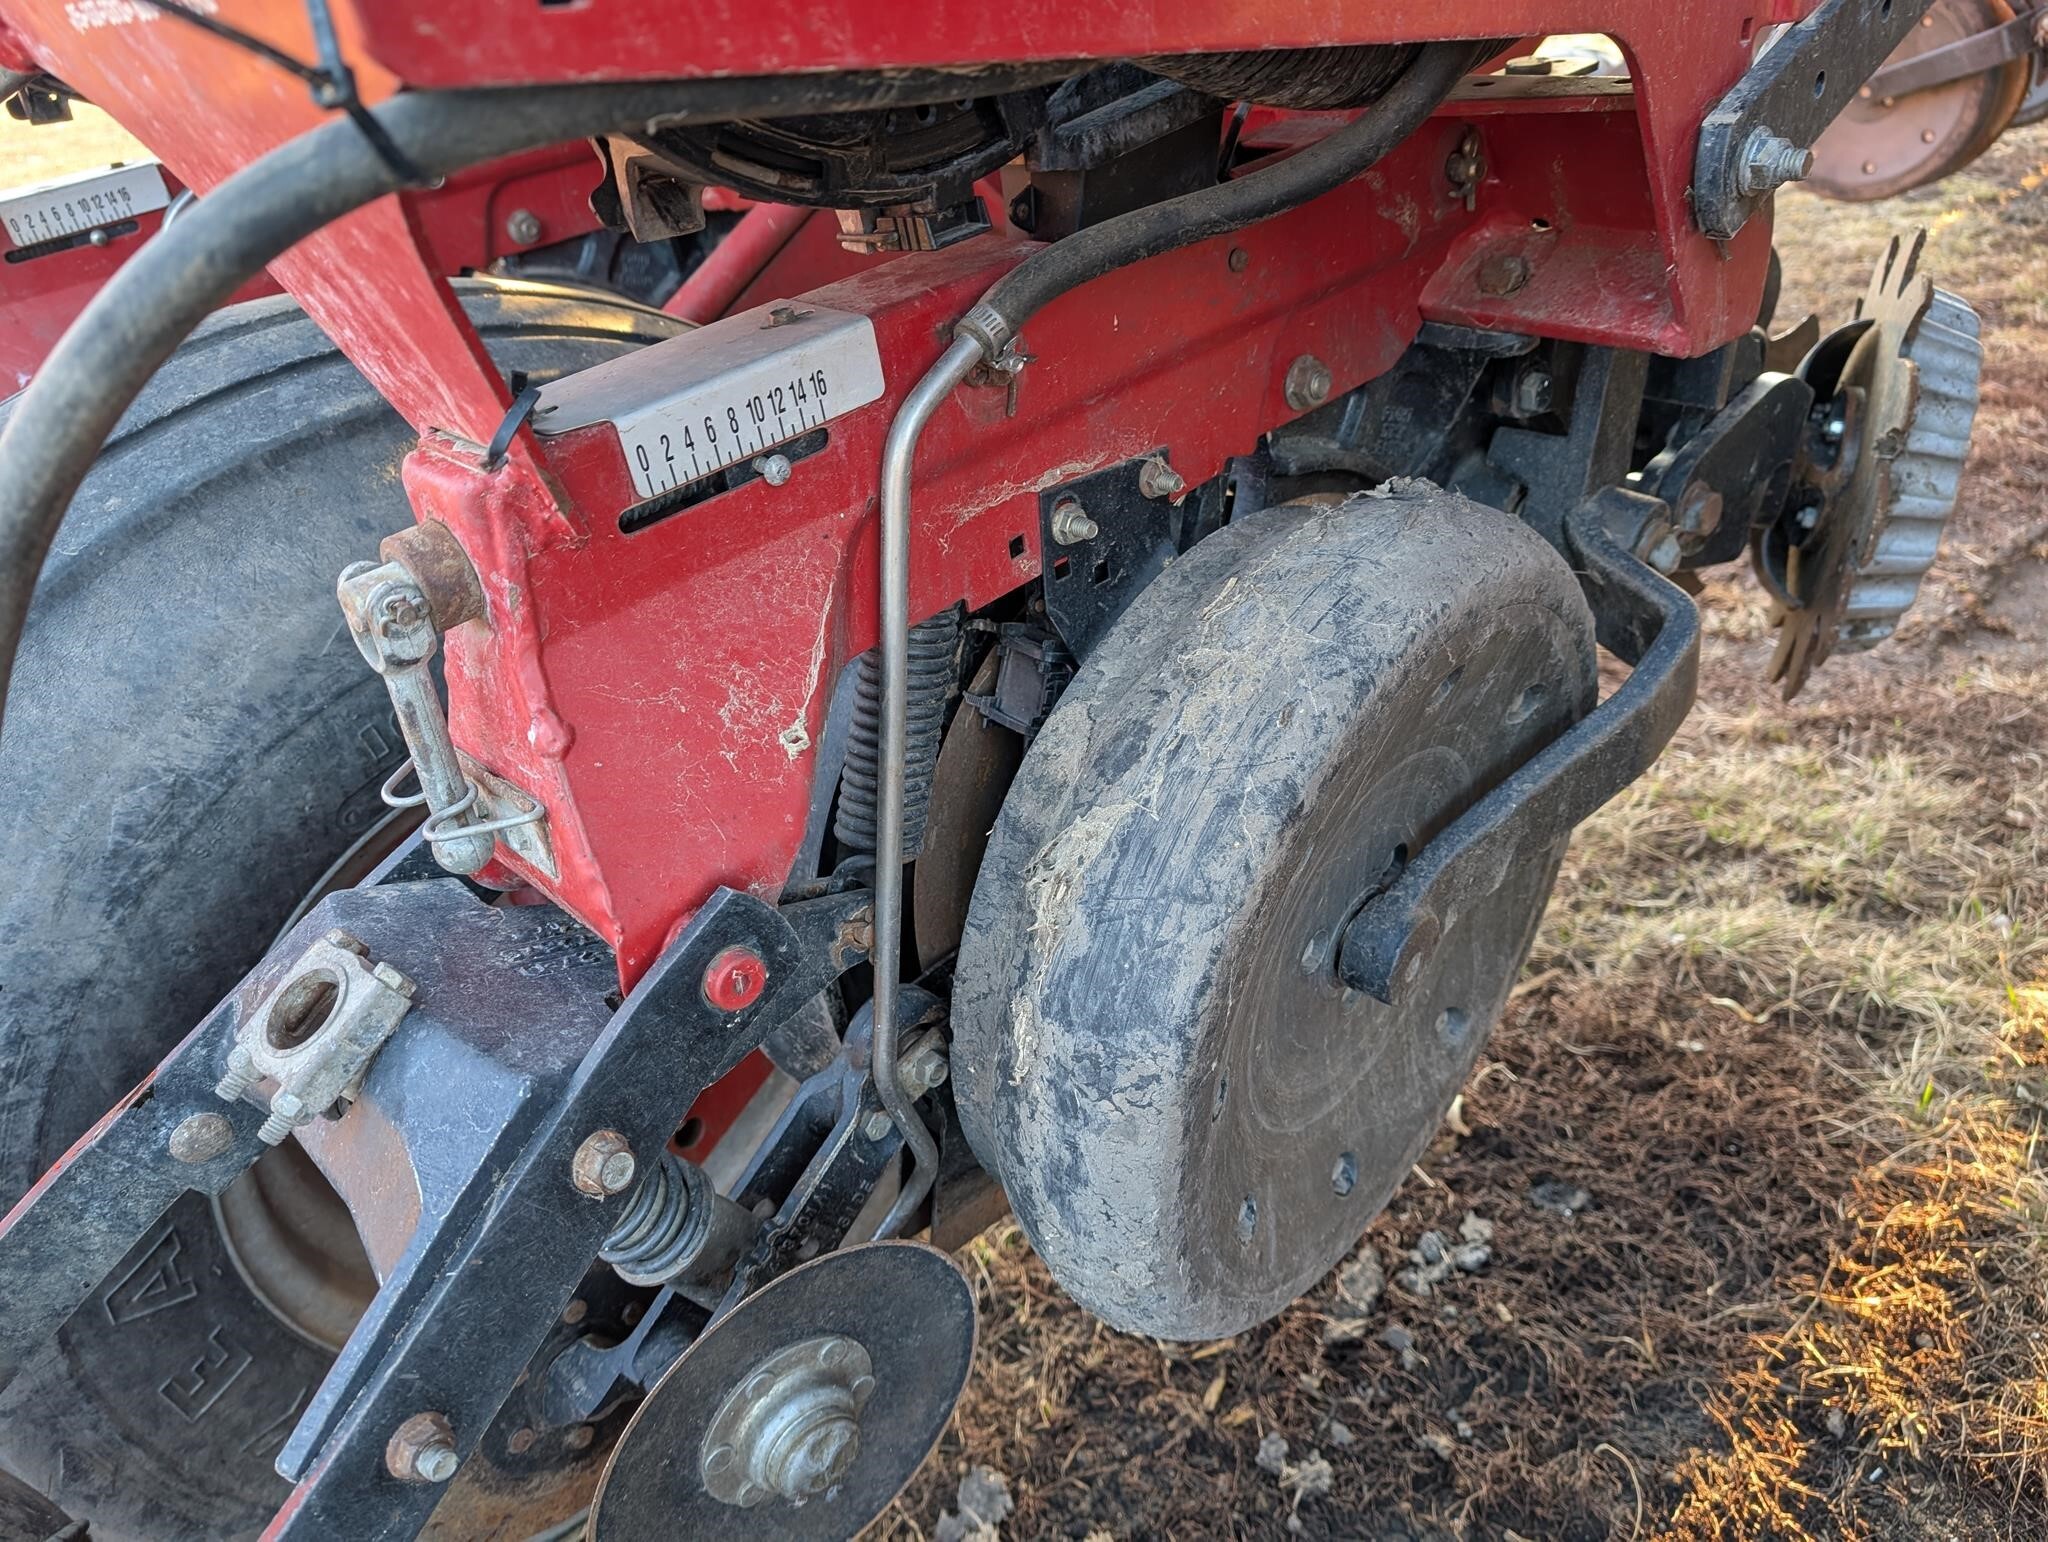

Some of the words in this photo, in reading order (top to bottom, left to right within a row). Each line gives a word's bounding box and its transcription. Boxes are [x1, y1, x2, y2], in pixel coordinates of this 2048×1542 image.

[9, 217, 20, 233] 0
[24, 213, 35, 229] 2
[38, 210, 47, 223] 4
[50, 206, 61, 221] 6
[65, 202, 75, 217] 8
[77, 198, 91, 214] 10
[90, 194, 104, 209] 12
[104, 190, 117, 206] 14
[117, 186, 131, 202] 16
[635, 443, 650, 472] 0
[660, 434, 674, 462] 2
[684, 425, 695, 451] 4
[704, 416, 717, 443] 6
[727, 406, 740, 434] 8
[745, 396, 765, 425] 10
[767, 386, 786, 416] 12
[788, 377, 807, 407] 14
[809, 369, 827, 398] 16
